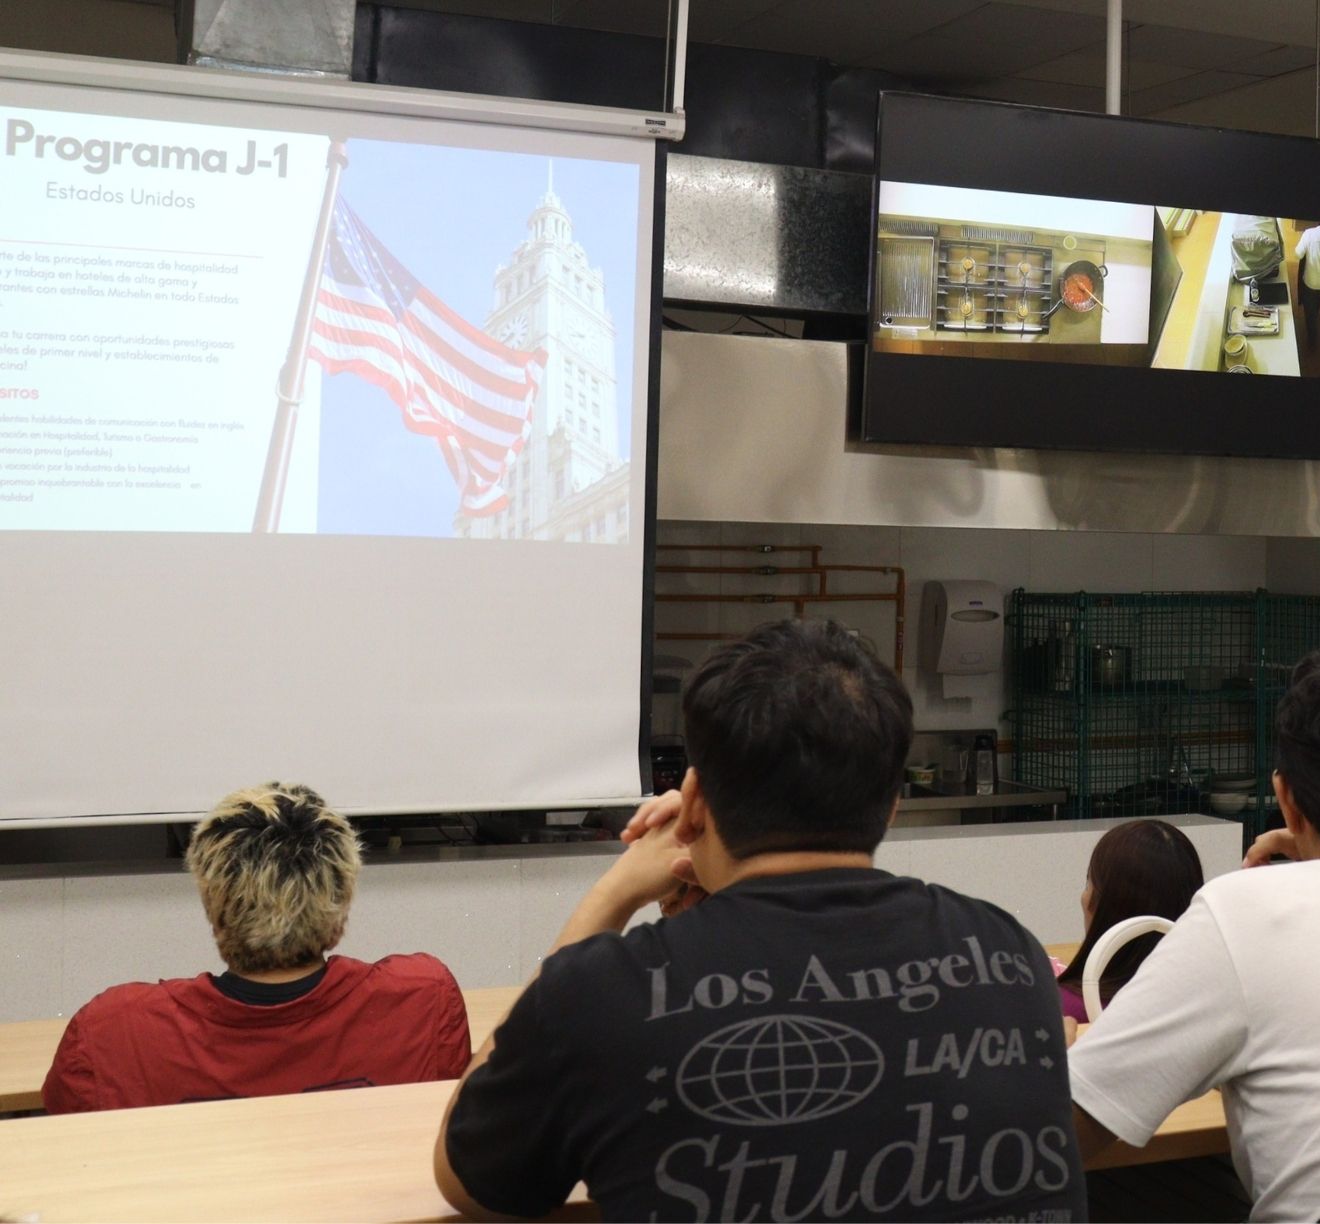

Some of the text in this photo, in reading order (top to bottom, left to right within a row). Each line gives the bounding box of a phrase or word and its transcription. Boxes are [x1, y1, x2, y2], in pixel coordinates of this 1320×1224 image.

[6, 118, 289, 178] Programa J-1
[46, 181, 196, 209] Estados Unidos
[17, 250, 31, 261] de
[35, 251, 50, 262] las
[53, 254, 112, 267] principales
[115, 260, 155, 270] marcas
[157, 260, 172, 271] de
[174, 260, 238, 275] hospitalidad
[15, 266, 55, 280] trabaja
[58, 271, 72, 280] en
[75, 269, 114, 282] hoteles
[117, 272, 131, 283] de
[134, 272, 156, 285] alta
[158, 277, 189, 288] gama
[36, 285, 56, 294] con
[60, 285, 104, 297] estrellas
[107, 287, 152, 299] Michelin
[154, 291, 168, 300] en
[171, 291, 196, 302] todo
[198, 292, 239, 304] Estados
[12, 330, 23, 340] tu
[25, 331, 66, 341] carrera
[69, 334, 90, 342] con
[92, 333, 170, 346] oportunidades
[173, 338, 235, 351] prestigiosas
[22, 344, 37, 355] de
[40, 347, 75, 359] primer
[78, 347, 102, 358] nivel
[113, 349, 203, 363] establecimientos
[205, 352, 219, 364] de
[645, 936, 1035, 1021] Los Angeles
[905, 1027, 1027, 1079] LA/CA
[650, 1102, 1070, 1224] Studios
